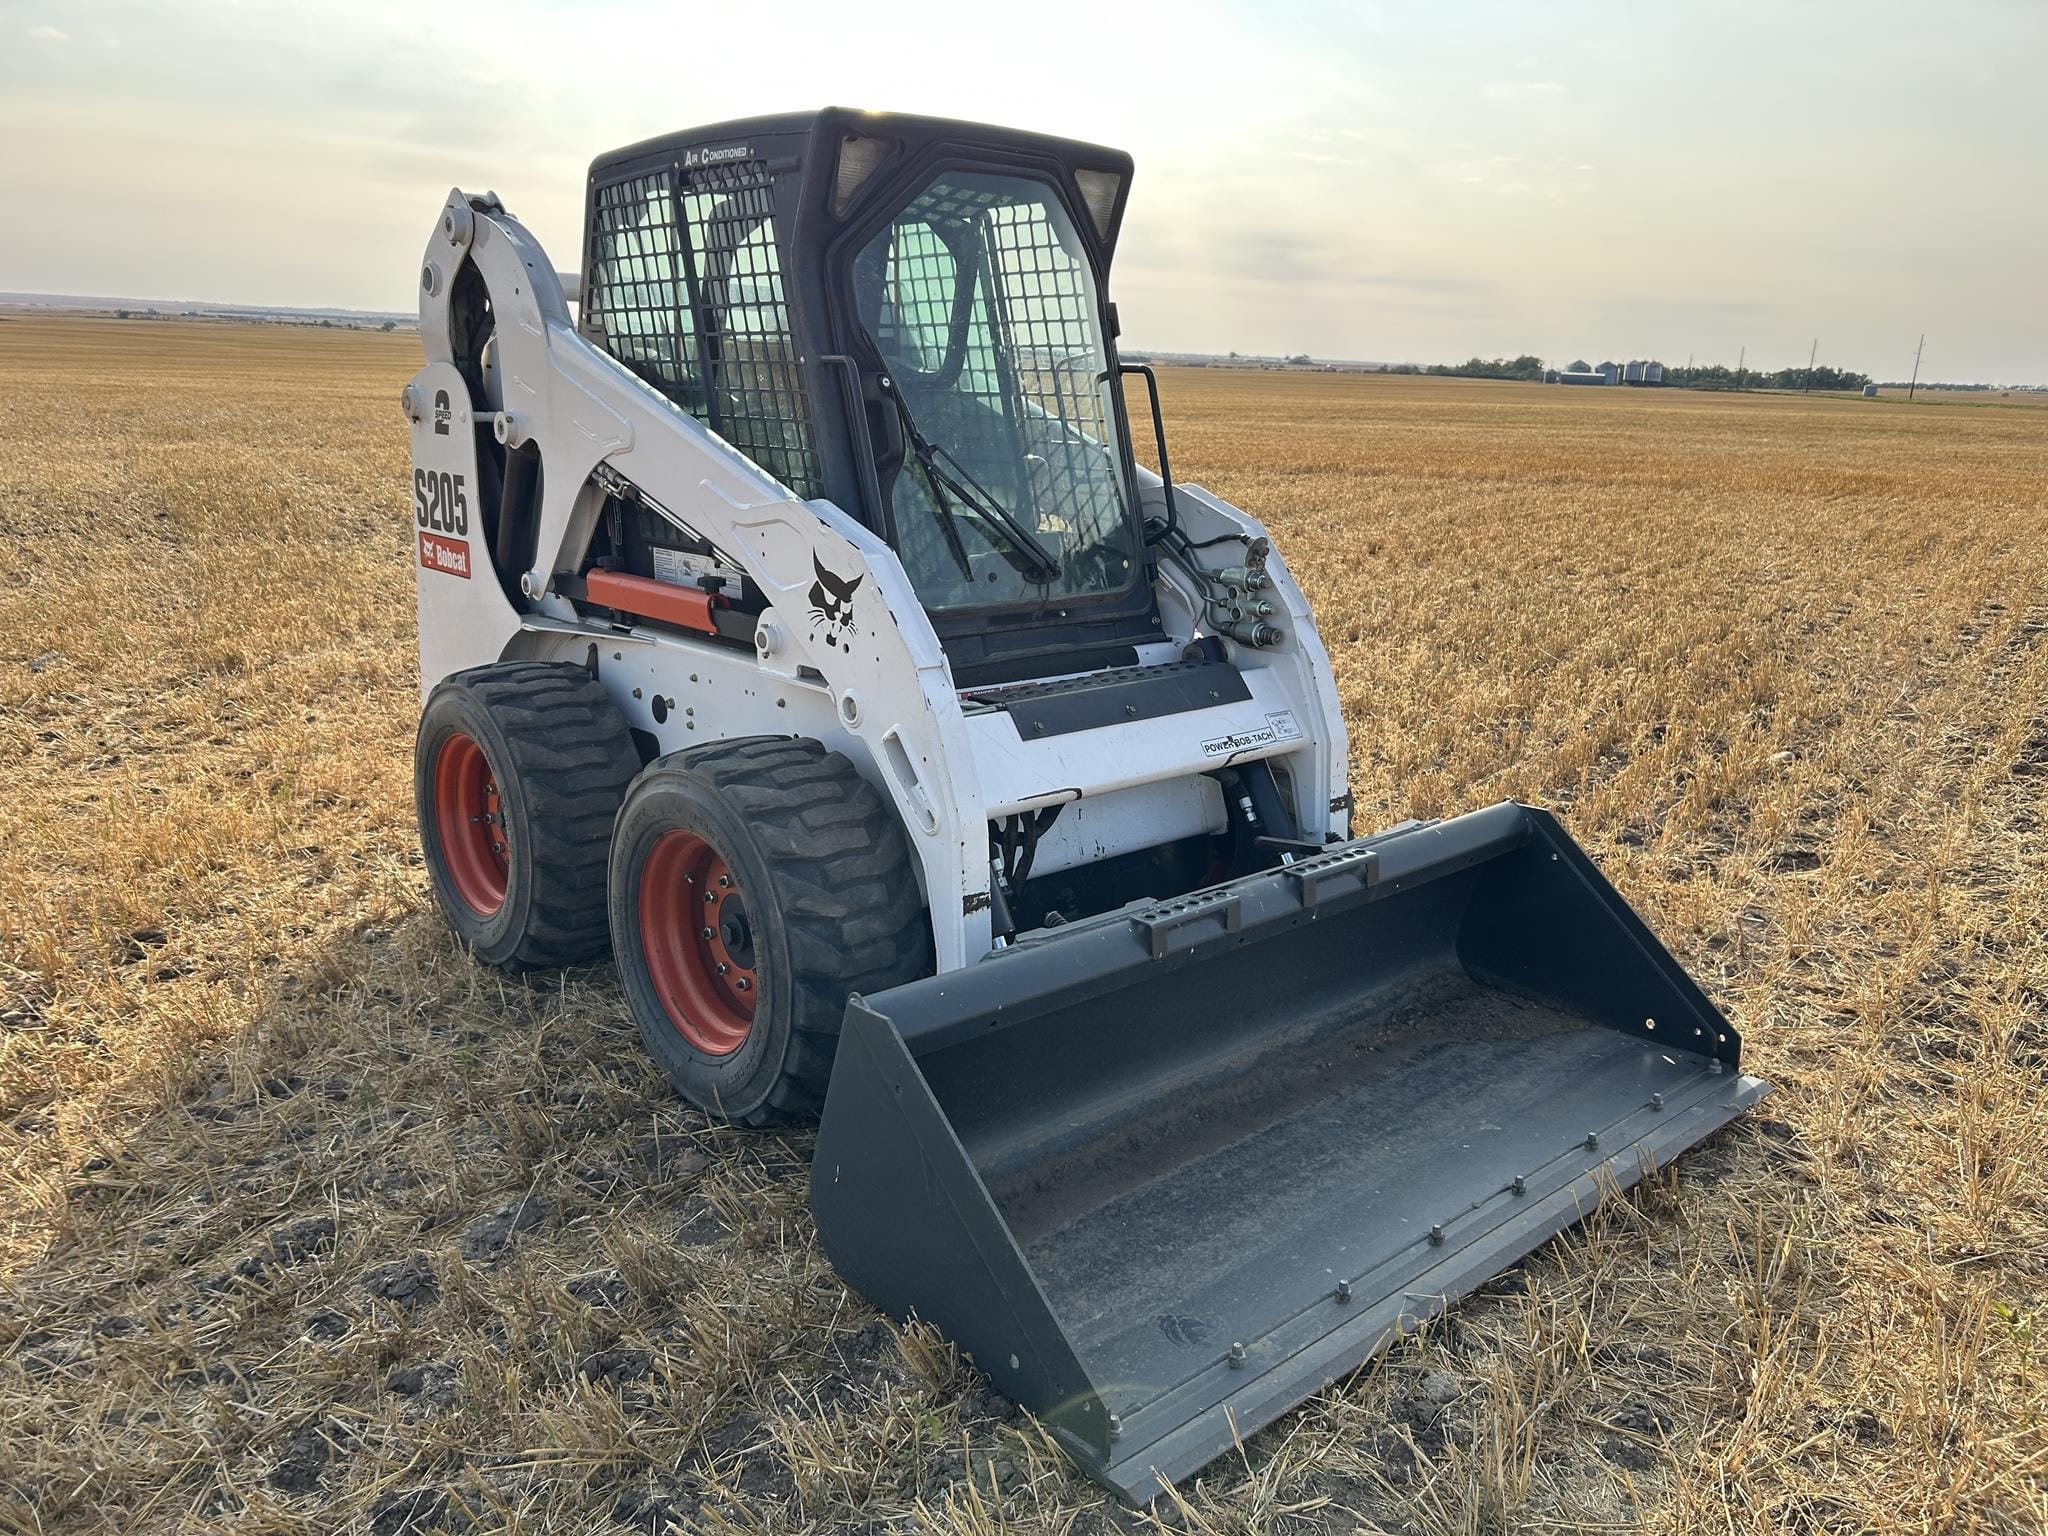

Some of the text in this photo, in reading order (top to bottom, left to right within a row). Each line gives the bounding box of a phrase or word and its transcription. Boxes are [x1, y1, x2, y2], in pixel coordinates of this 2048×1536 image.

[434, 389, 450, 435] 2
[434, 409, 452, 420] SPEED
[414, 468, 468, 536] S205
[436, 544, 467, 572] Bobcat
[1234, 731, 1274, 747] BOB-TACH
